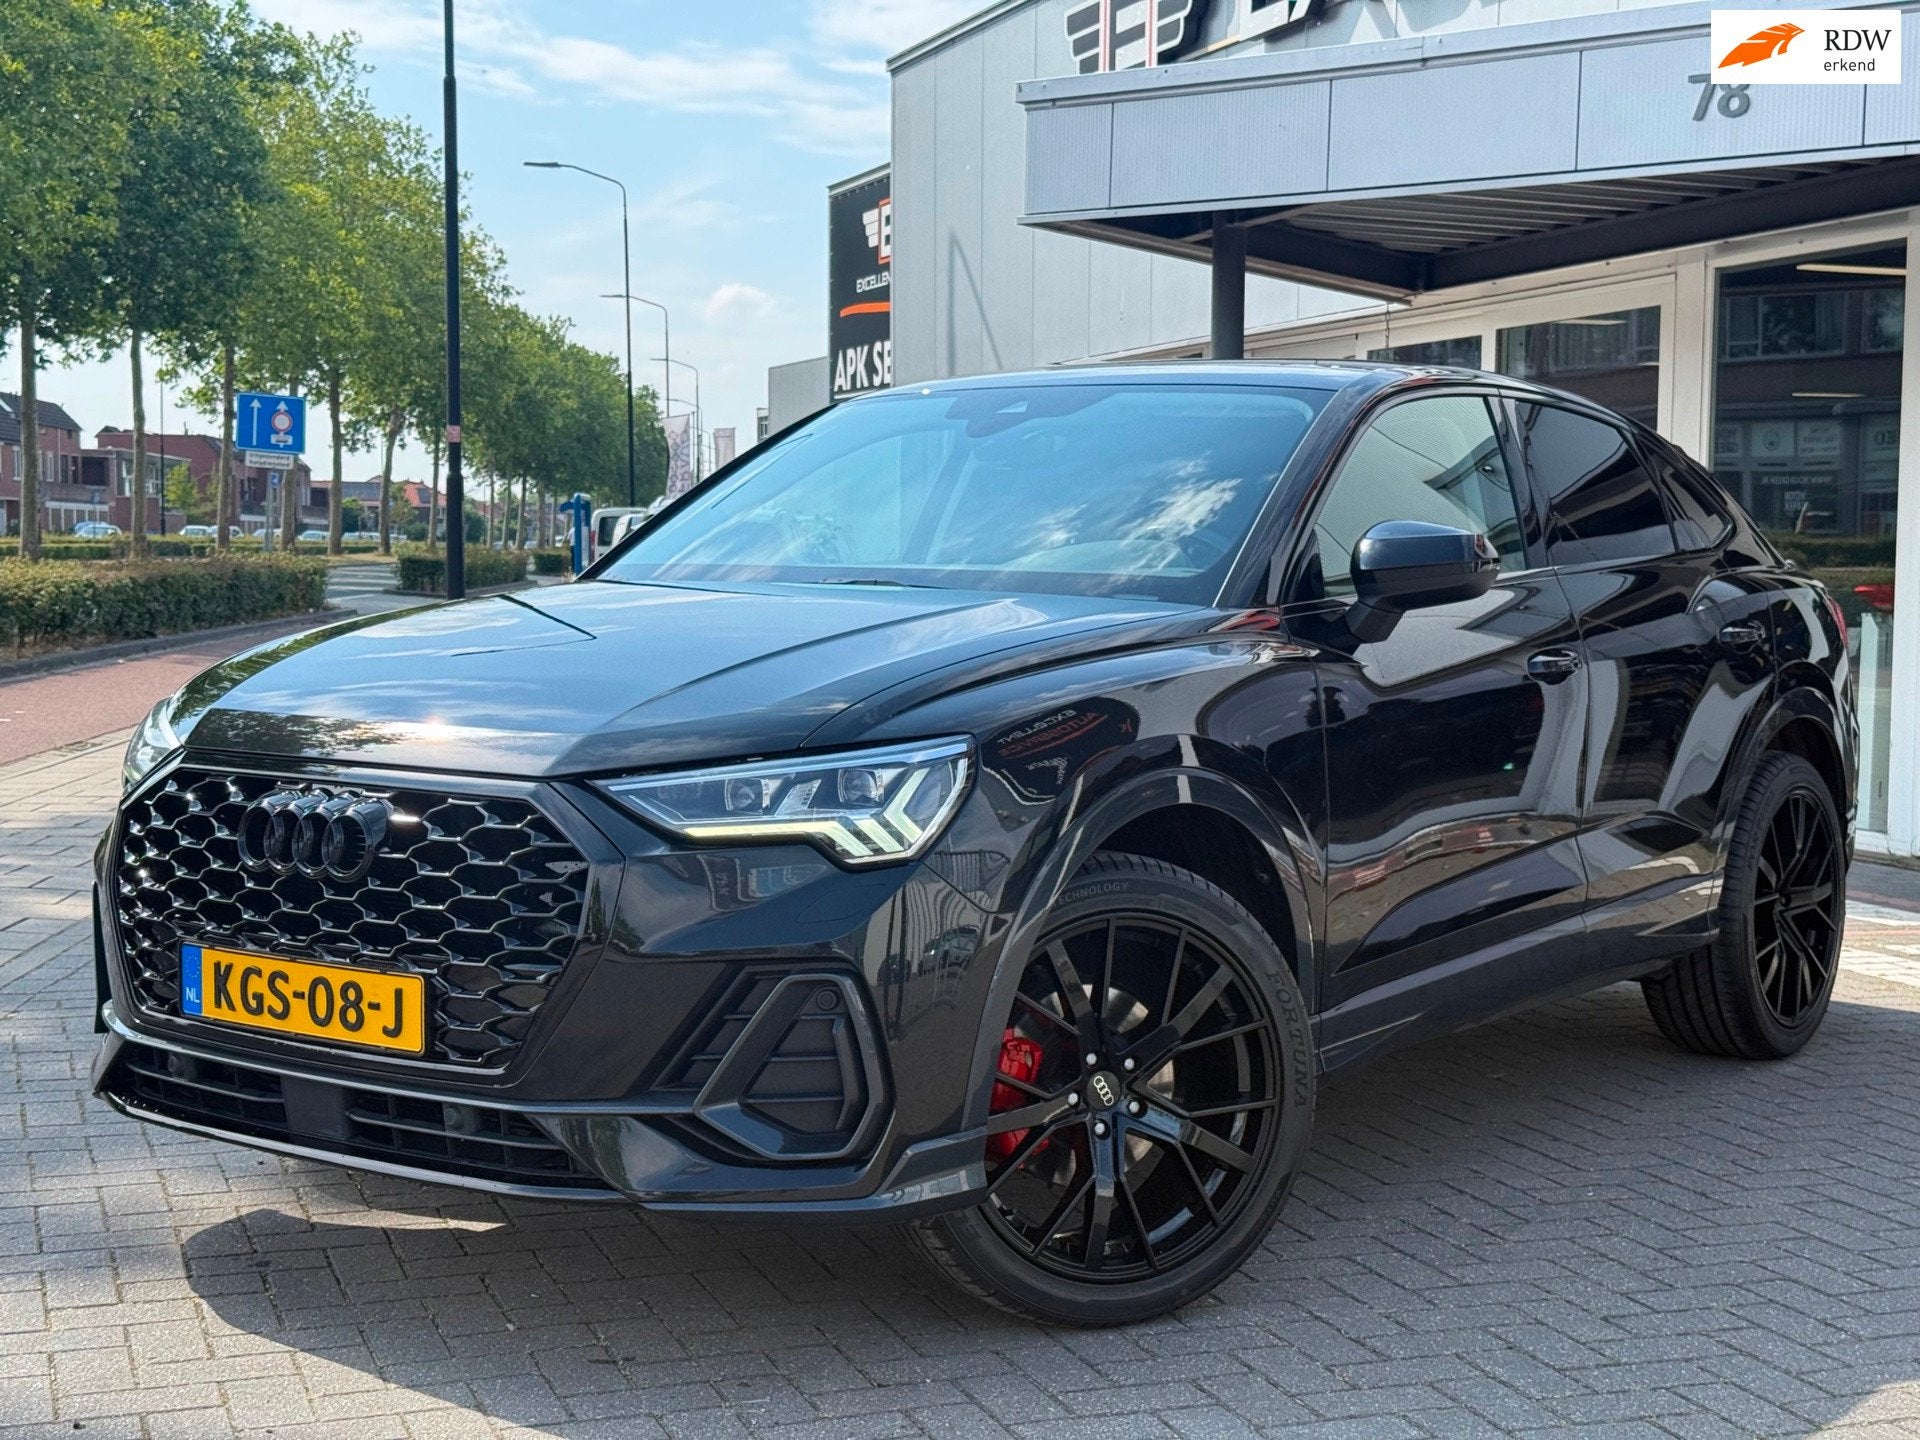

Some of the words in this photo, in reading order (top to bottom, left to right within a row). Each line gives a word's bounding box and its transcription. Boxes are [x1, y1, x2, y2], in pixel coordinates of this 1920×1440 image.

[834, 345, 869, 392] APK
[1057, 881, 1129, 905] ECHNOLOGY
[185, 986, 200, 1003] NL
[213, 960, 403, 1039] KGS-08-J
[1264, 969, 1308, 1108] FORTUNA
